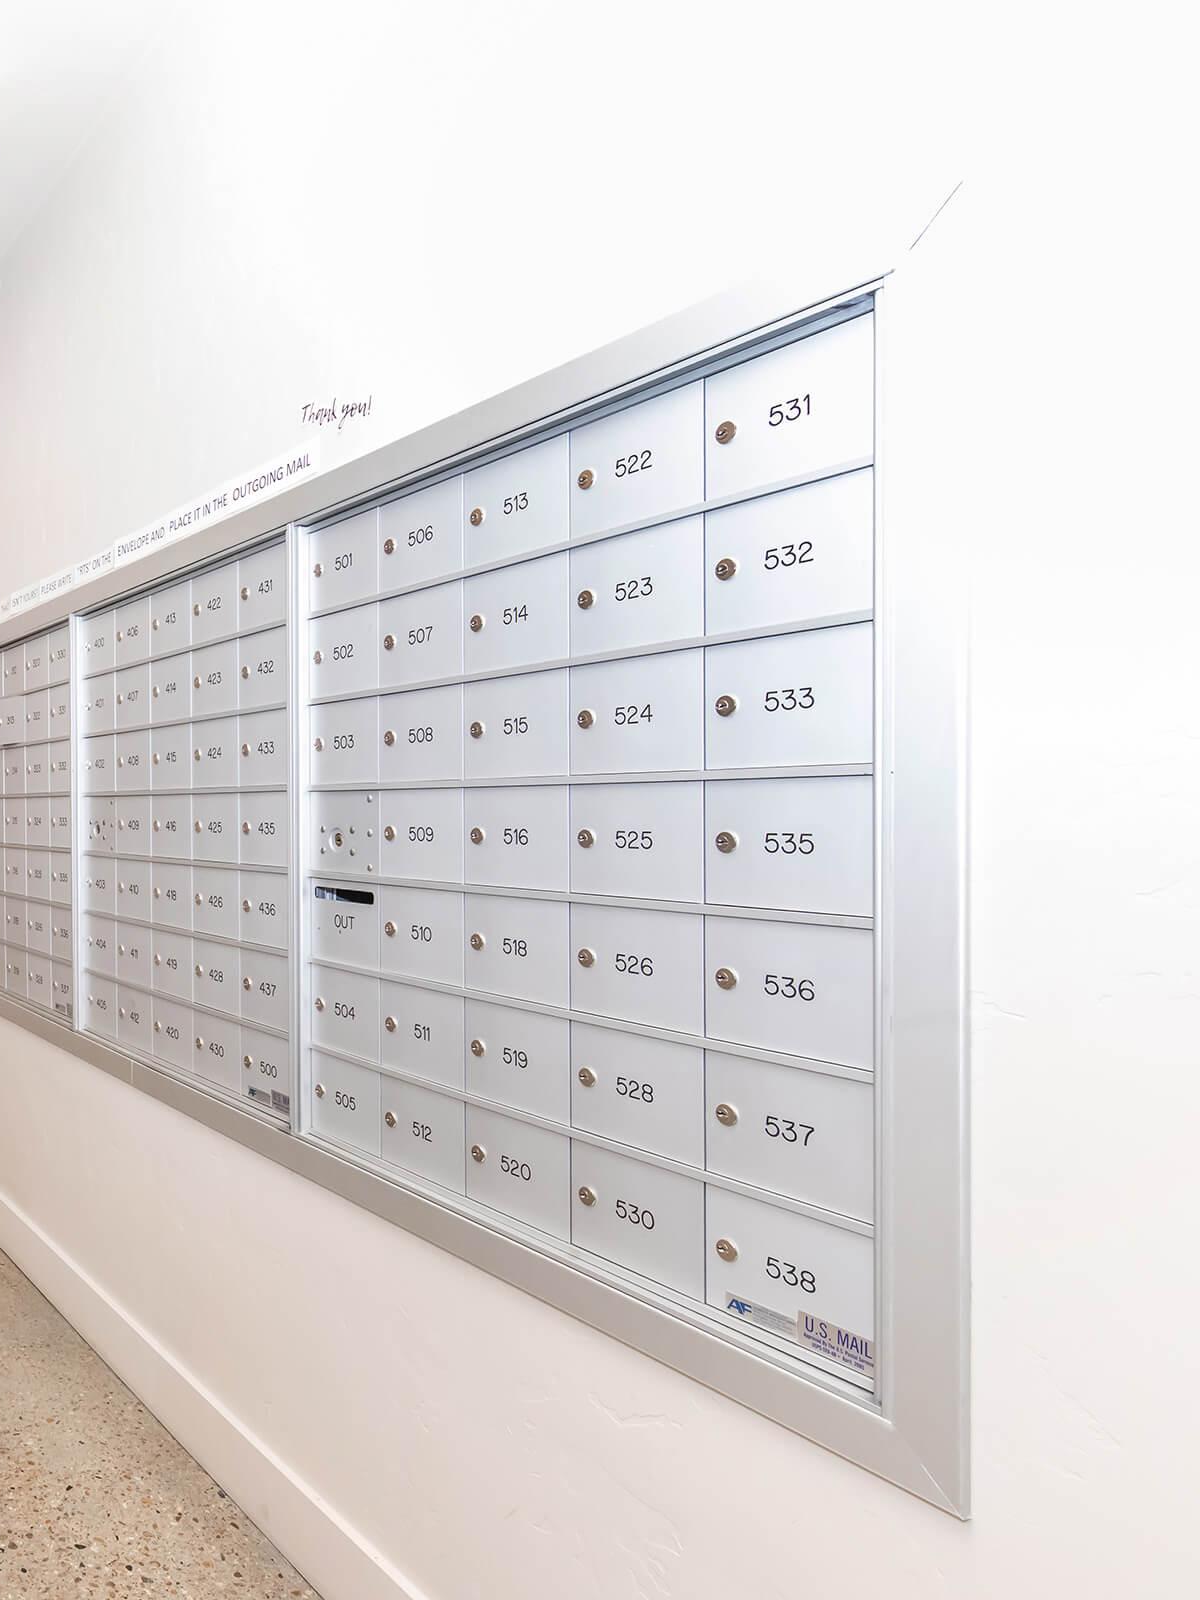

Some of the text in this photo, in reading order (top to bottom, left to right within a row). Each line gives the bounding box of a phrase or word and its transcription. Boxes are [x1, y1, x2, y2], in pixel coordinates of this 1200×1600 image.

[301, 395, 372, 430] Thank you!
[769, 394, 810, 426] 531
[615, 450, 652, 477] 522
[504, 492, 528, 514] 513
[40, 580, 57, 595] PLEASE
[57, 574, 72, 588] WRITE
[92, 560, 101, 571] ON
[102, 552, 112, 565] THE
[117, 533, 149, 557] ENVELOPE
[150, 527, 165, 544] AND
[169, 511, 192, 533] PLACE
[193, 507, 201, 521] IT
[202, 502, 212, 517] IN
[212, 494, 228, 512] THE
[232, 466, 284, 502] OUTGOING
[286, 453, 311, 479] MAIL
[408, 525, 433, 546] 506
[335, 553, 352, 571] 501
[764, 541, 814, 570] 532
[259, 580, 272, 593] 431
[615, 577, 652, 601] 523
[207, 597, 221, 610] 422
[166, 613, 176, 624] 413
[503, 605, 528, 625] 514
[127, 625, 138, 637] 406
[408, 626, 432, 645] 507
[94, 637, 104, 648] 400
[333, 644, 353, 660] 502
[258, 660, 273, 673] 432
[208, 672, 221, 684] 423
[128, 690, 138, 701] 407
[166, 683, 176, 693] 414
[96, 699, 104, 708] 401
[764, 687, 814, 712] 533
[615, 704, 653, 725] 524
[504, 717, 528, 735] 515
[334, 735, 354, 749] 503
[408, 727, 433, 743] 508
[208, 747, 221, 759] 424
[258, 742, 274, 754] 433
[95, 759, 104, 768] 402
[128, 755, 138, 766] 408
[166, 752, 176, 762] 415
[128, 820, 139, 830] 409
[166, 821, 176, 831] 416
[208, 822, 222, 833] 425
[258, 823, 275, 835] 435
[409, 827, 433, 842] 509
[504, 828, 528, 845] 516
[615, 831, 652, 849] 525
[764, 833, 814, 854] 535
[96, 880, 105, 889] 403
[129, 884, 138, 895] 410
[166, 890, 176, 901] 418
[209, 896, 223, 908] 426
[259, 903, 275, 916] 436
[334, 914, 355, 929] OUT
[411, 925, 432, 942] 510
[96, 939, 106, 949] 404
[503, 938, 527, 957] 518
[167, 959, 177, 969] 419
[615, 954, 653, 976] 526
[209, 969, 223, 982] 428
[260, 983, 276, 996] 437
[764, 974, 814, 1001] 536
[97, 1000, 106, 1010] 405
[335, 1003, 355, 1020] 504
[130, 1012, 139, 1024] 412
[166, 1026, 178, 1039] 420
[414, 1024, 430, 1041] 511
[209, 1043, 224, 1057] 430
[503, 1048, 527, 1068] 519
[260, 1061, 277, 1078] 500
[616, 1077, 653, 1103] 528
[336, 1091, 356, 1110] 505
[413, 1122, 432, 1142] 512
[765, 1116, 814, 1146] 537
[501, 1155, 531, 1181] 520
[616, 1200, 654, 1229] 530
[766, 1257, 816, 1293] 538
[805, 1316, 832, 1341] U.S.
[838, 1330, 873, 1359] MAIL
